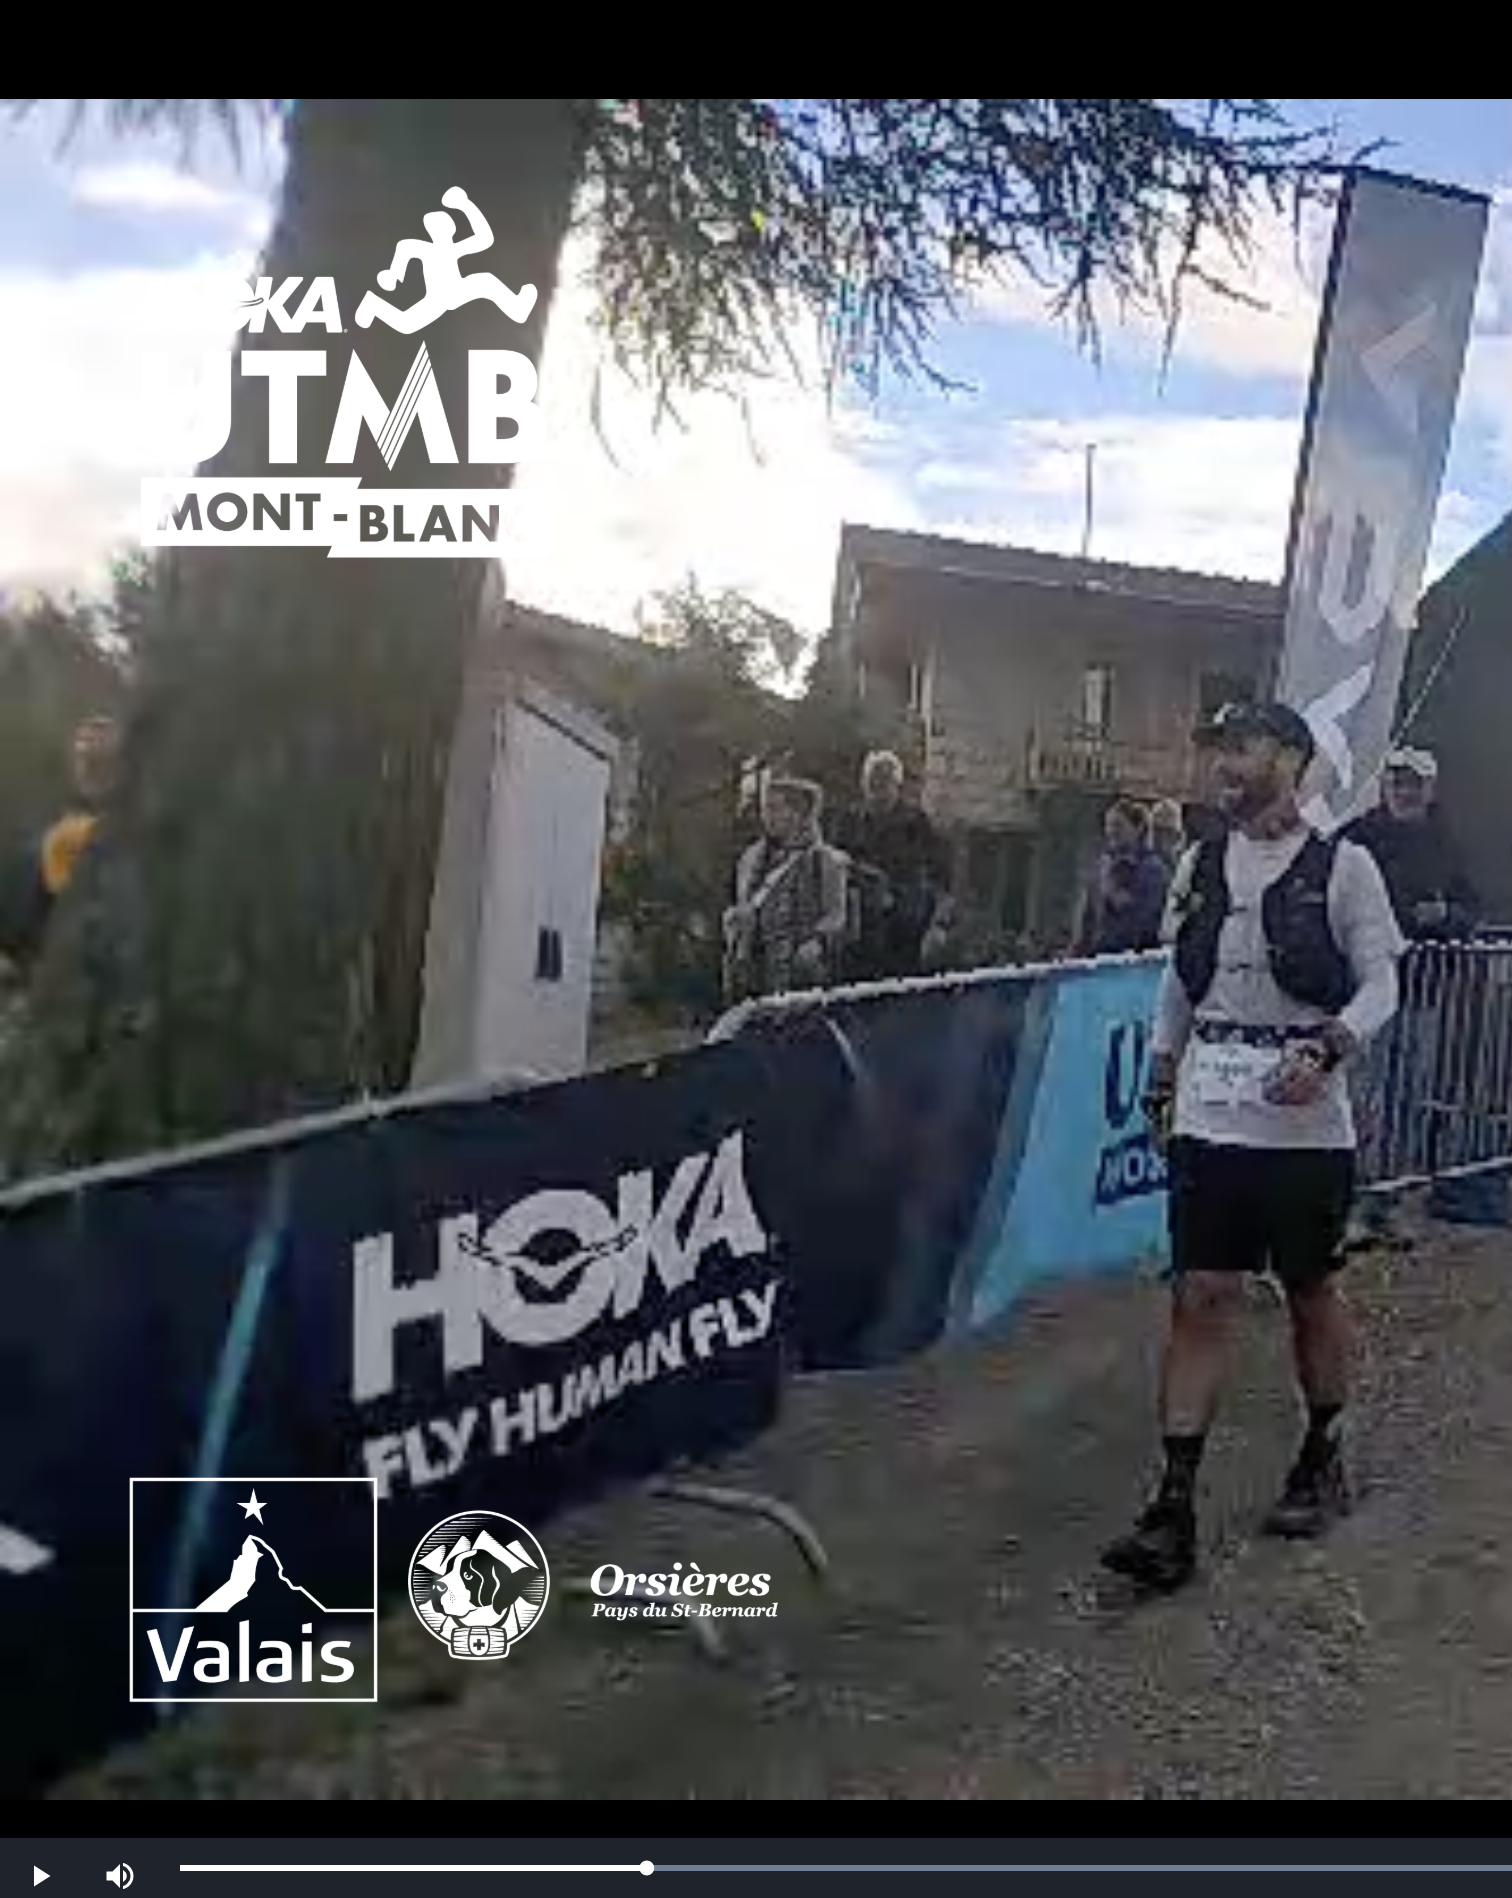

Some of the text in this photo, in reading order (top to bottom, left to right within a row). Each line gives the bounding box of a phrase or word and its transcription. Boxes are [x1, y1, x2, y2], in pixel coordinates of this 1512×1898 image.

[352, 1128, 768, 1404] HOKA
[361, 1279, 782, 1499] FLY HUMAN FLY
